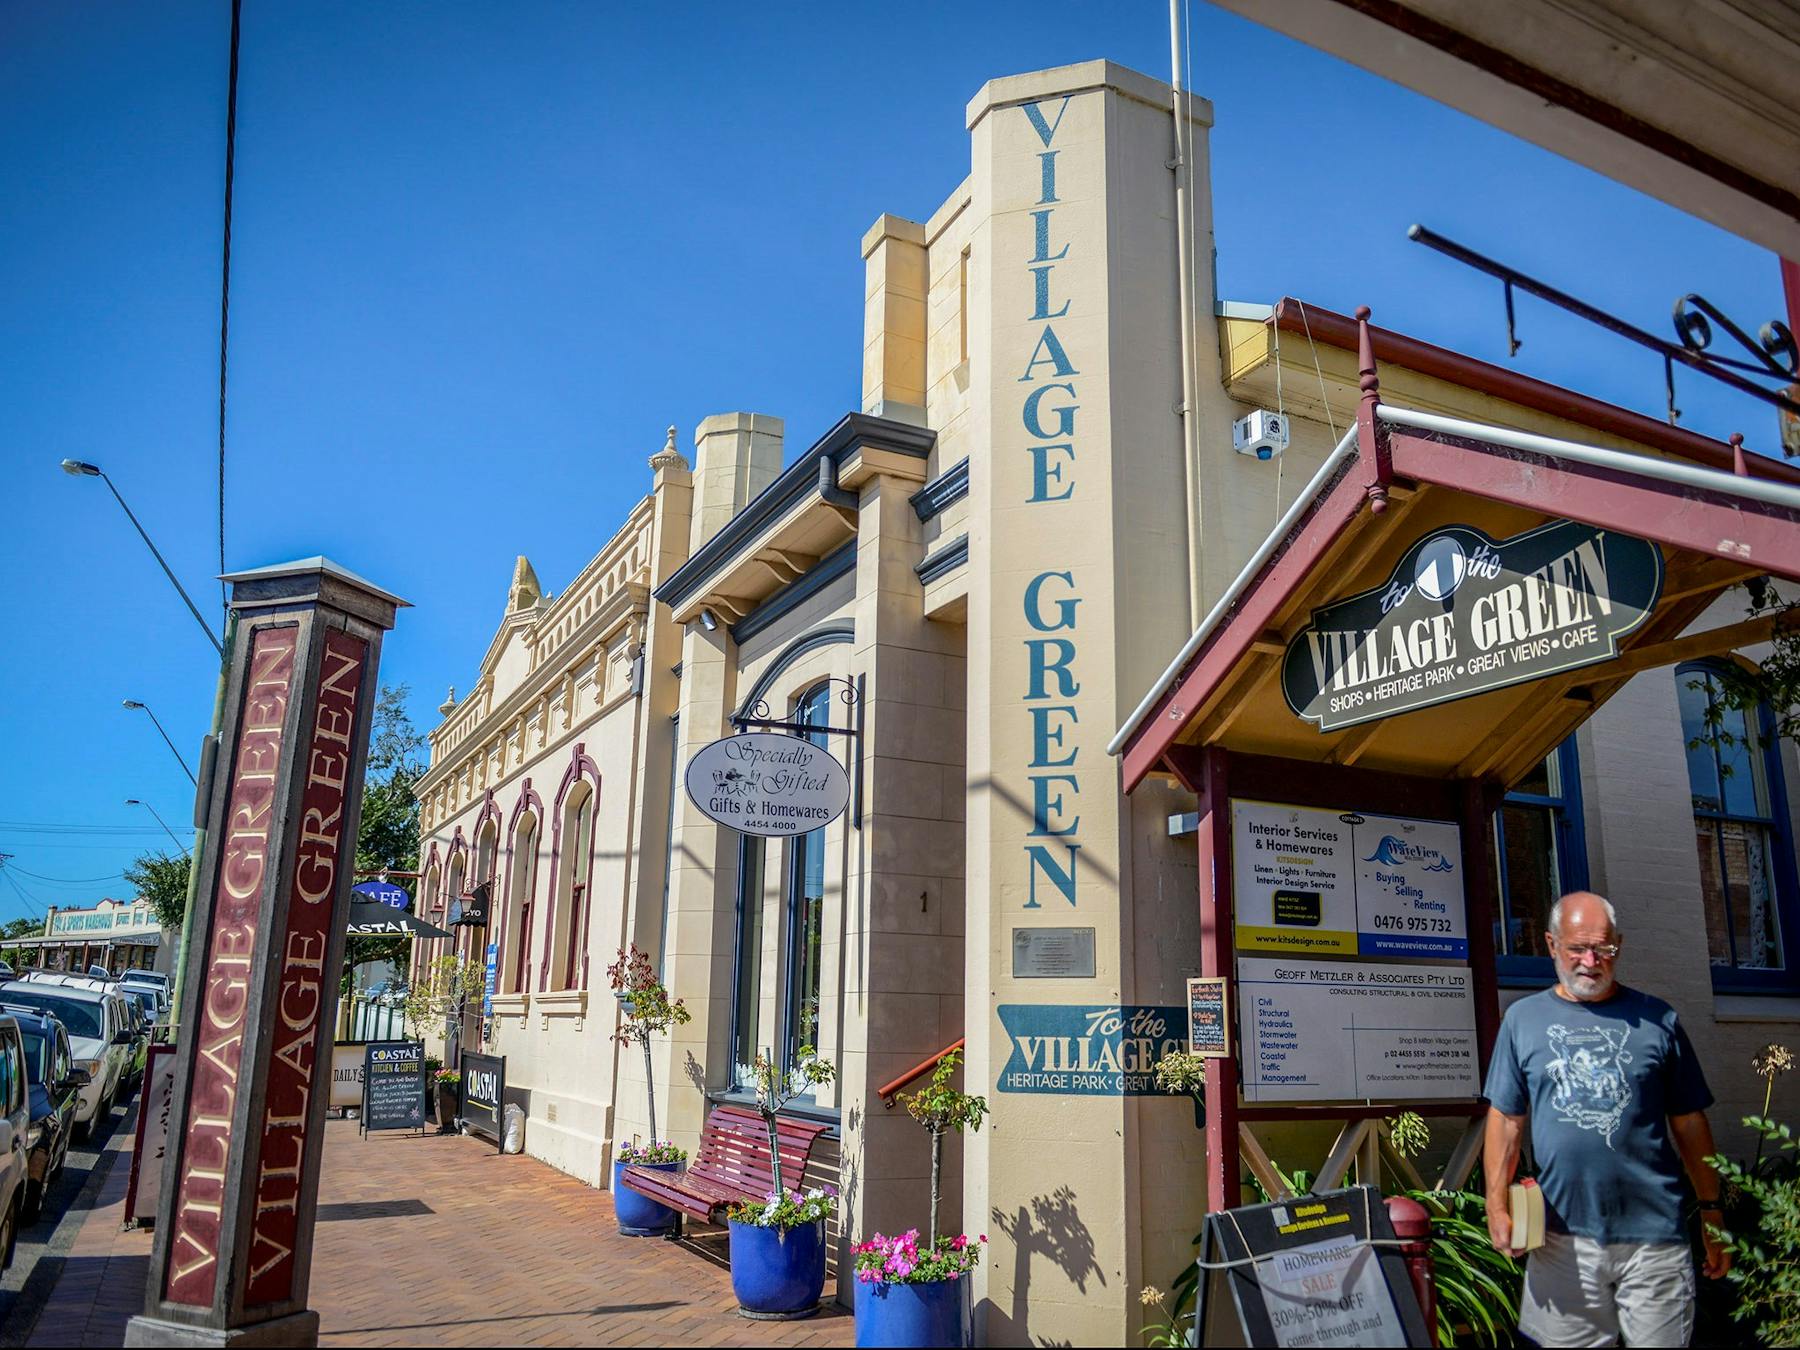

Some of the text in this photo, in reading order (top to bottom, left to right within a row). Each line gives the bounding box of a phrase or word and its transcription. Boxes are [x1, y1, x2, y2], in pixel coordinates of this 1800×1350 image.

[1017, 95, 1080, 503] VILLAGE
[1468, 544, 1502, 580] the
[1306, 532, 1612, 695] VILLAGE GREEN
[1330, 625, 1598, 712] SHOPS HERITAGE PARK GREAT VIEWS CAFE
[1023, 571, 1082, 908] GREEN
[725, 740, 812, 771] Specially
[762, 770, 829, 796] Gifted
[710, 798, 829, 819] Gifts & Homewares
[744, 820, 796, 830] 4454 4000
[1249, 822, 1338, 841] Interior Services
[1256, 839, 1333, 855] & Homewares
[1255, 865, 1336, 878] Linen Lights Furniture
[1376, 872, 1405, 885] Buying
[1257, 876, 1335, 889] Interior Design Service
[1395, 886, 1423, 899] Selling
[919, 891, 928, 912] 1
[1414, 900, 1446, 913] Renting
[1374, 915, 1451, 932] 0476 975 732
[1256, 935, 1340, 946] www.kitsdesign.com.au
[1375, 940, 1452, 951] www.waveview.com.au
[171, 644, 294, 1287] VILLAGE GREEN
[249, 643, 359, 1290] VILLAGE GREEN
[1274, 969, 1306, 979] GEOFF
[1310, 970, 1353, 981] METZLER
[1357, 972, 1365, 981] &
[1369, 972, 1424, 984] ASSOCIATES
[1330, 988, 1367, 996] CONSULTING
[1369, 989, 1409, 997] STRUCTURAL
[1258, 998, 1272, 1006] Civil
[1259, 1009, 1289, 1017] Structural
[1130, 1009, 1166, 1037] the
[1259, 1019, 1293, 1028] Hydraulics
[1260, 1030, 1297, 1039] Stormwater
[1260, 1041, 1299, 1049] Wastewater
[372, 1048, 420, 1060] COASTAL
[1015, 1036, 1154, 1073] VILLAGE
[1260, 1052, 1286, 1060] Coastal
[394, 1063, 400, 1073] &
[400, 1062, 418, 1073] COFFEE
[1261, 1063, 1280, 1071] Traffic
[334, 1069, 358, 1082] DAILY
[1007, 1074, 1068, 1088] HERITAGE
[1073, 1075, 1107, 1090] PARK
[1115, 1076, 1148, 1091] GREAT
[1262, 1074, 1307, 1083] Management
[468, 1070, 498, 1104] COASTAL
[1284, 1245, 1351, 1272] HOMEWARE
[1302, 1273, 1337, 1295] SALE
[1339, 1292, 1366, 1312] OFF
[1286, 1313, 1384, 1348] come through and
